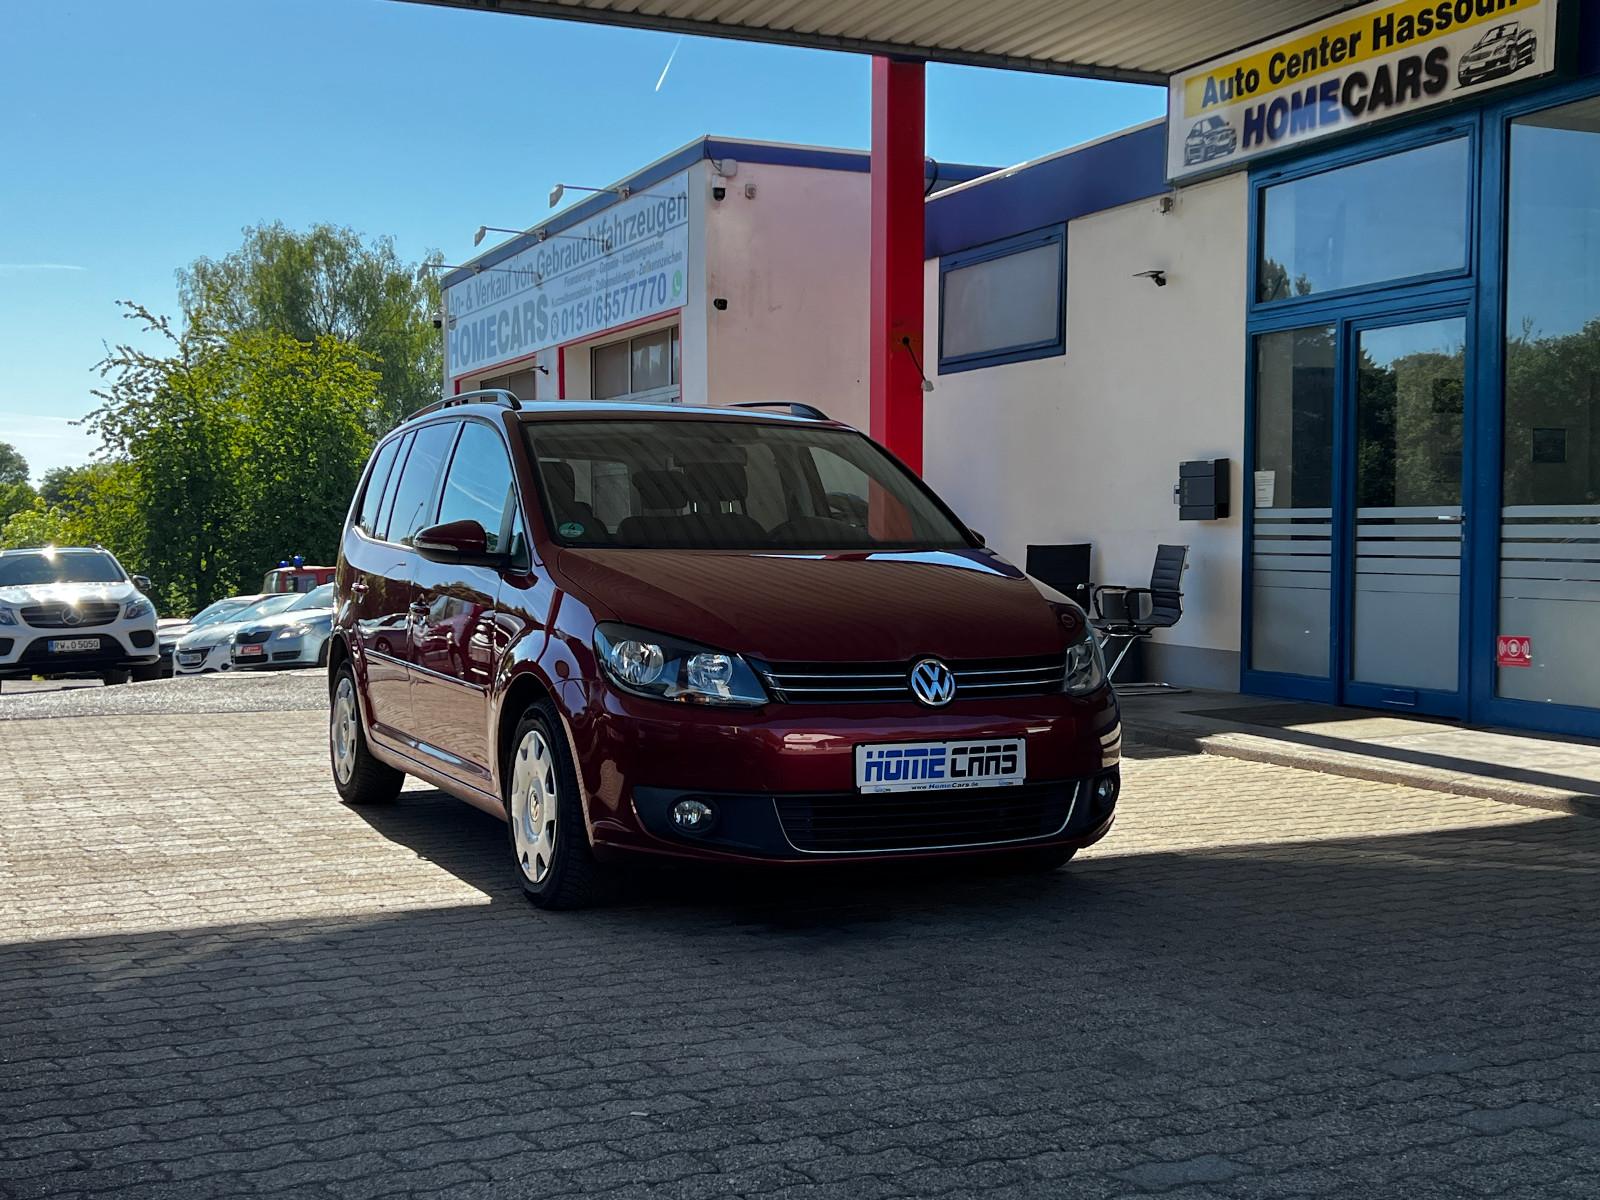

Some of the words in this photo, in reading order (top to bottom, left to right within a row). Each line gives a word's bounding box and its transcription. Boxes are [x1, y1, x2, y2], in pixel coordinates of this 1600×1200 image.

[1201, 70, 1259, 108] Auto
[1268, 29, 1362, 85] Center
[1242, 46, 1451, 148] HOMECARS
[466, 283, 473, 310] &
[475, 264, 512, 307] Verkauf
[514, 263, 534, 290] von
[537, 190, 688, 281] Gebrauchtfahrzeugen
[449, 293, 549, 370] HOMECARS
[912, 659, 955, 706] VW
[865, 747, 947, 782] HOME
[950, 743, 1018, 778] CARS
